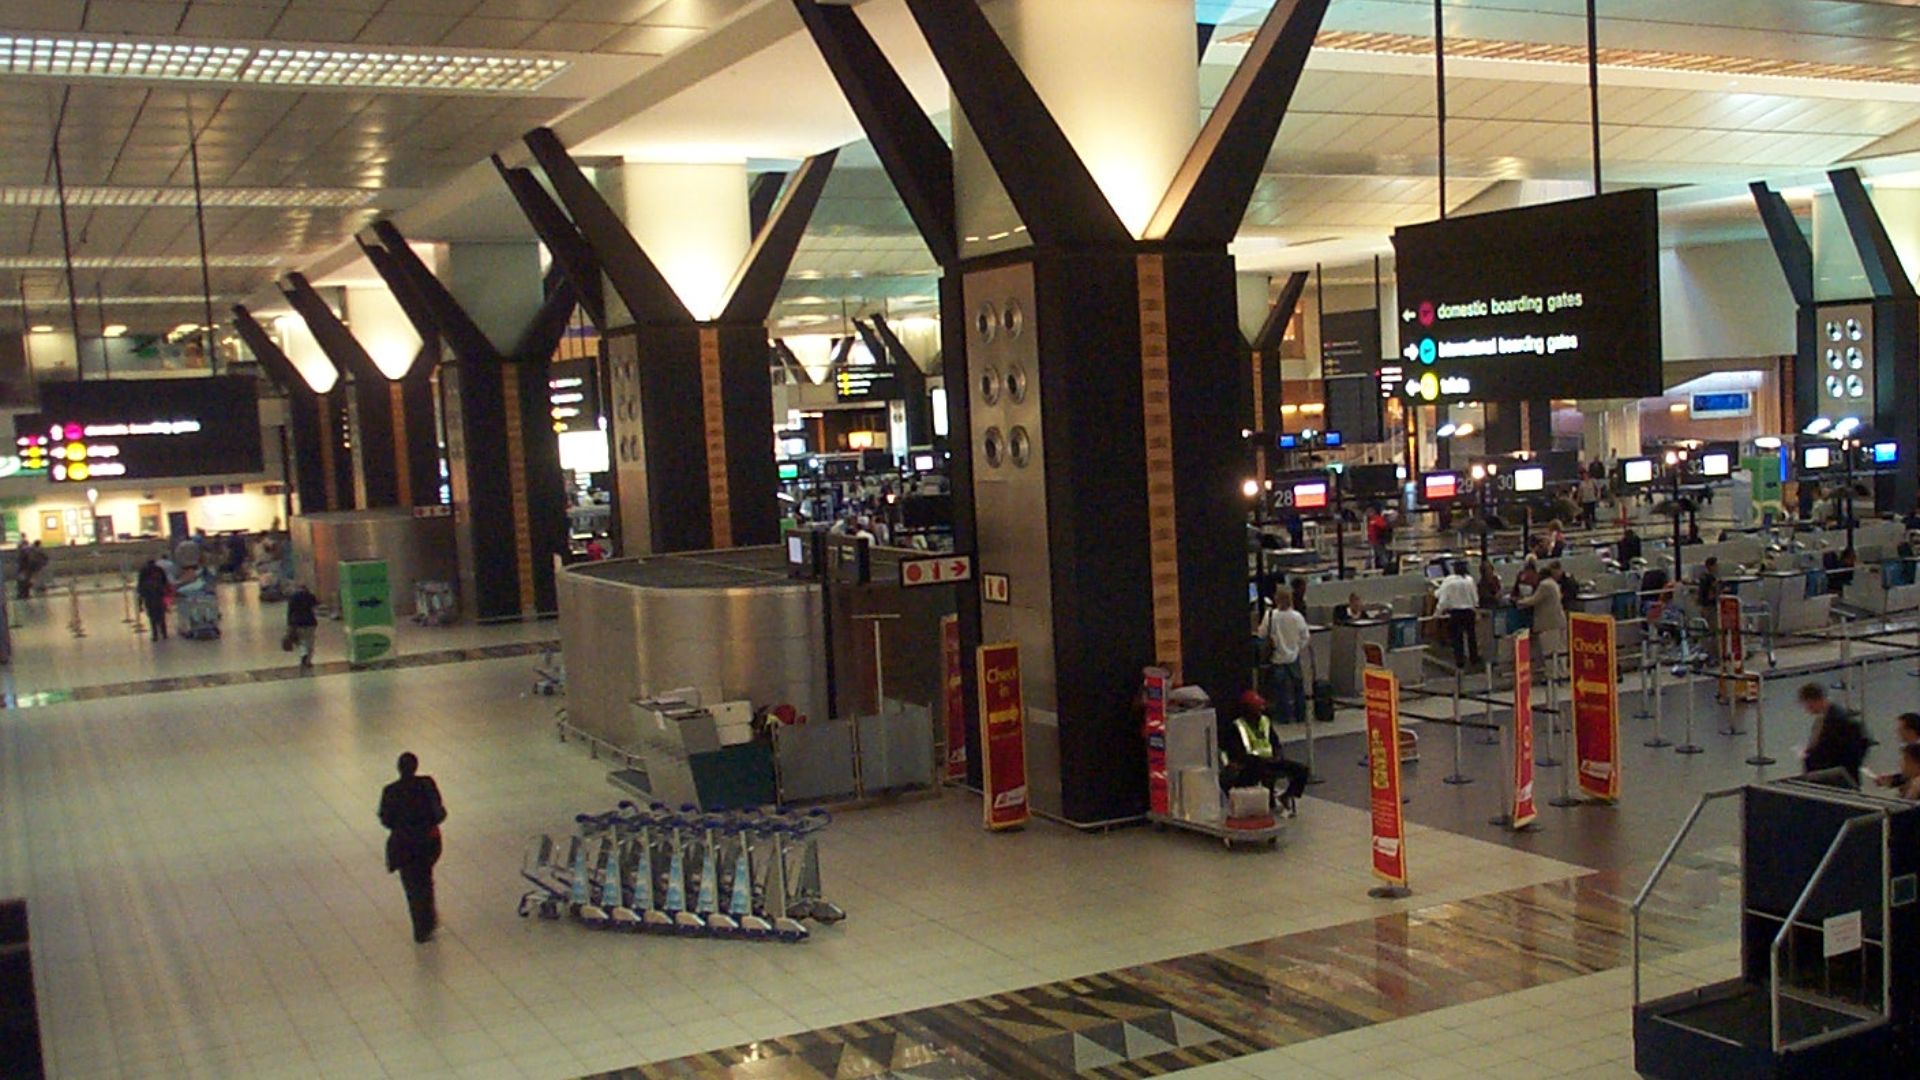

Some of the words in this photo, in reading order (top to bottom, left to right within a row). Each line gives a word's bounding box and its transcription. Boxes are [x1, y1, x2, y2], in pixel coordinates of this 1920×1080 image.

[1438, 301, 1488, 319] domestic
[1492, 296, 1543, 314] boarding
[1547, 292, 1583, 312] gates
[1498, 335, 1544, 355] bding
[1457, 479, 1474, 494] 29
[1497, 475, 1514, 490] 30
[1274, 490, 1293, 508] 28
[1574, 637, 1606, 655] Check
[1583, 653, 1594, 670] in
